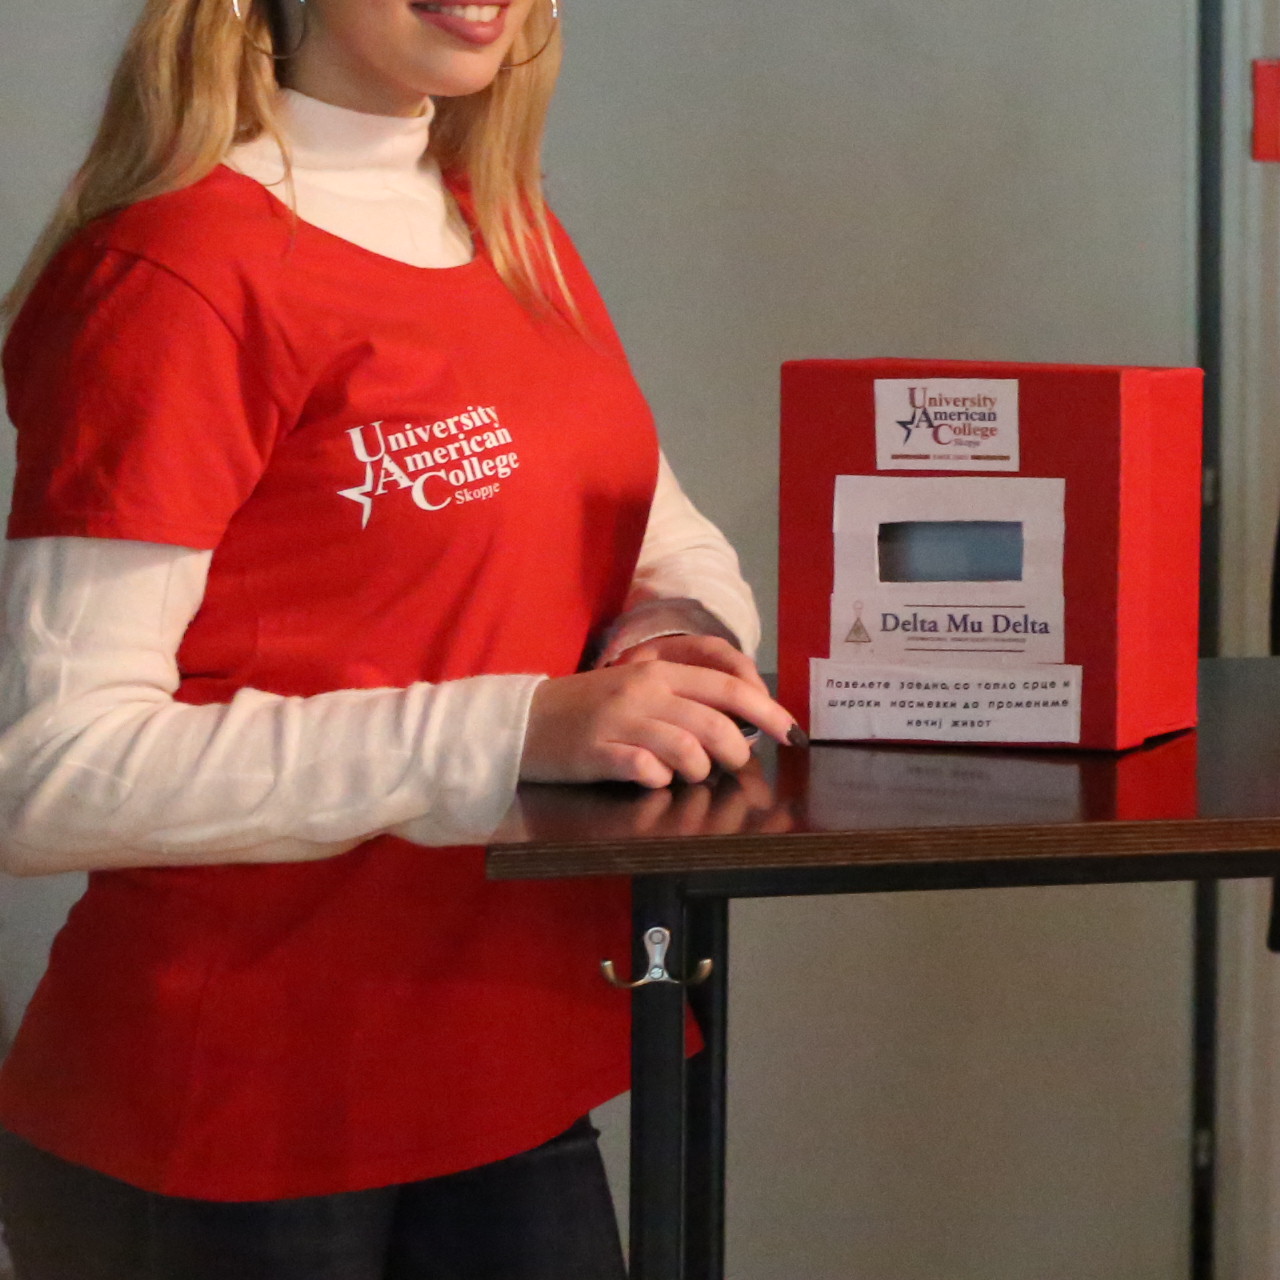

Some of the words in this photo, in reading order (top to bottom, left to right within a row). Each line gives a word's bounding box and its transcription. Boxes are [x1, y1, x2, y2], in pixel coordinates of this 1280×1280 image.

[908, 387, 997, 411] University
[916, 407, 996, 428] American
[345, 405, 499, 463] University
[932, 423, 998, 445] College
[375, 426, 513, 496] American
[411, 452, 519, 511] College
[455, 482, 500, 504] Skopje
[880, 612, 939, 632] Delta
[947, 613, 983, 633] Mu
[992, 614, 1050, 634] Delta
